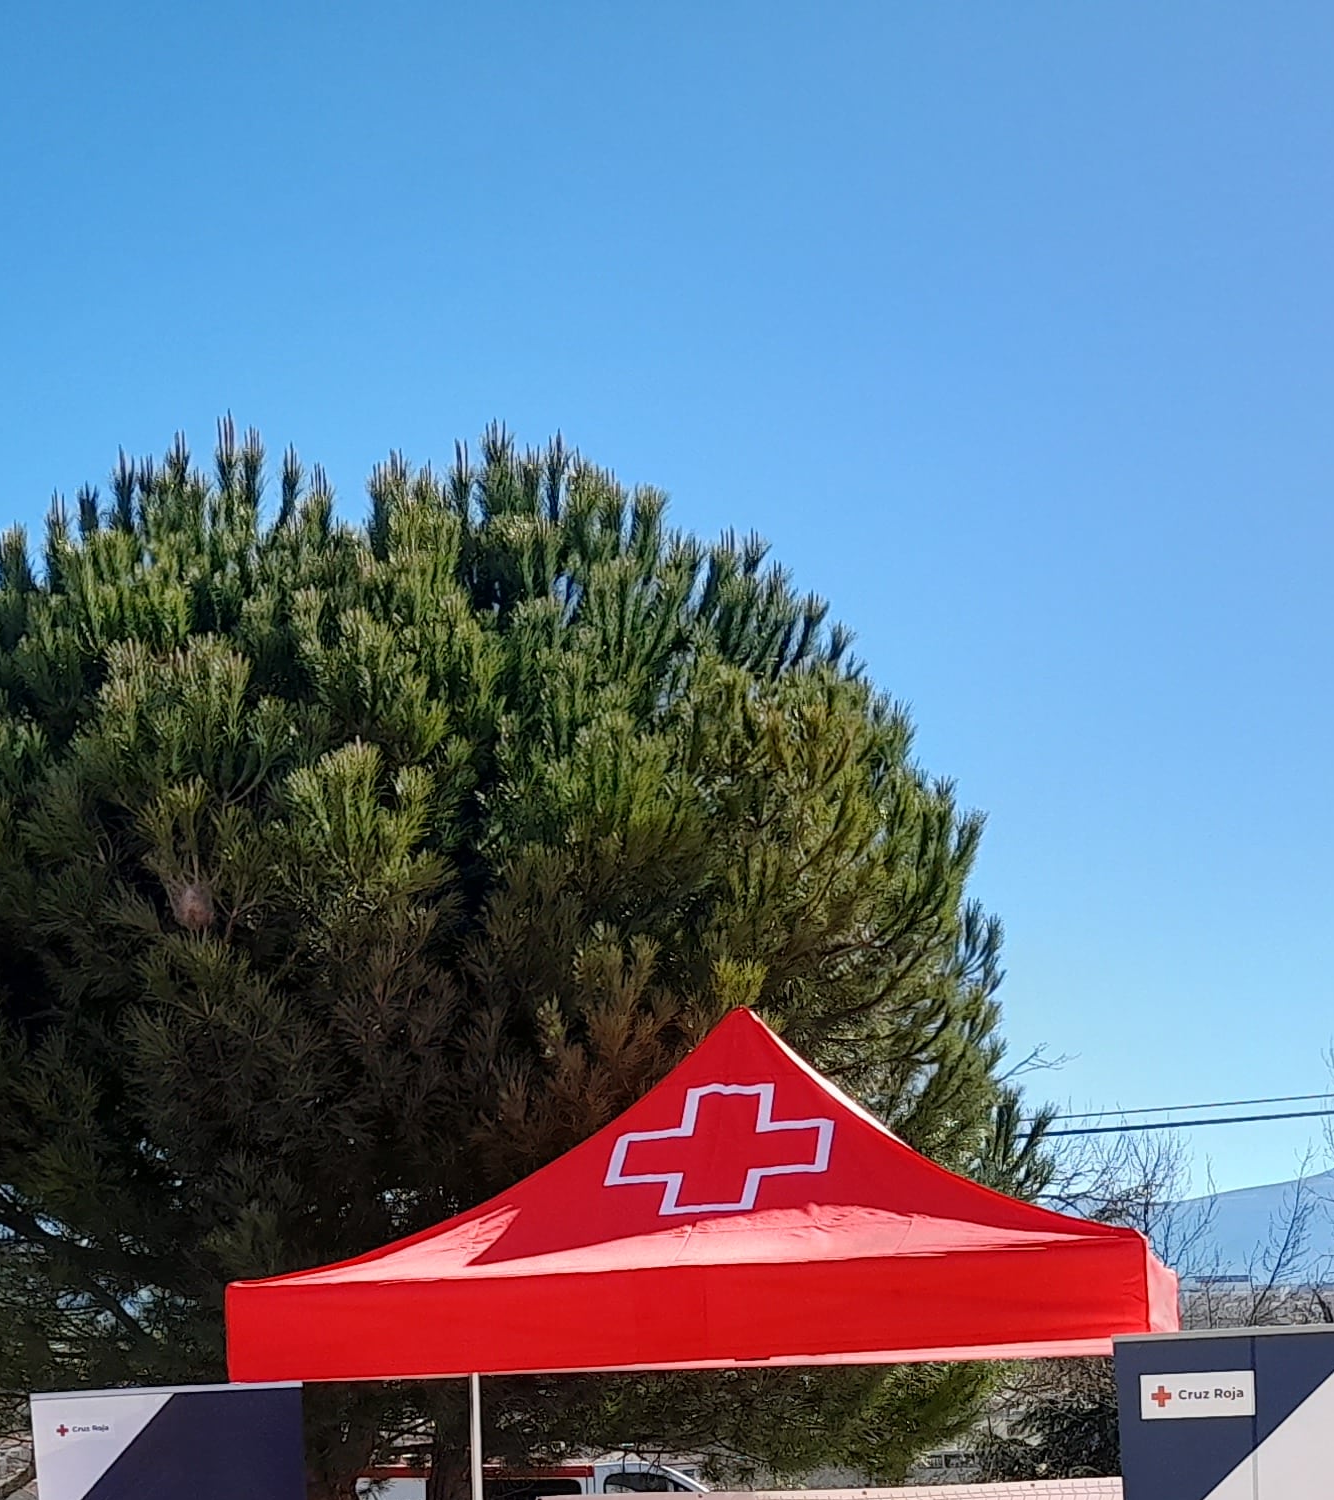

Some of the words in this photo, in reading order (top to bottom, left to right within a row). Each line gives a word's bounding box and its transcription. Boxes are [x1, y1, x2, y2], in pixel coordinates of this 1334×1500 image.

[1178, 1389, 1209, 1400] Cruz
[1214, 1387, 1244, 1401] Roja
[92, 1424, 109, 1433] Roja
